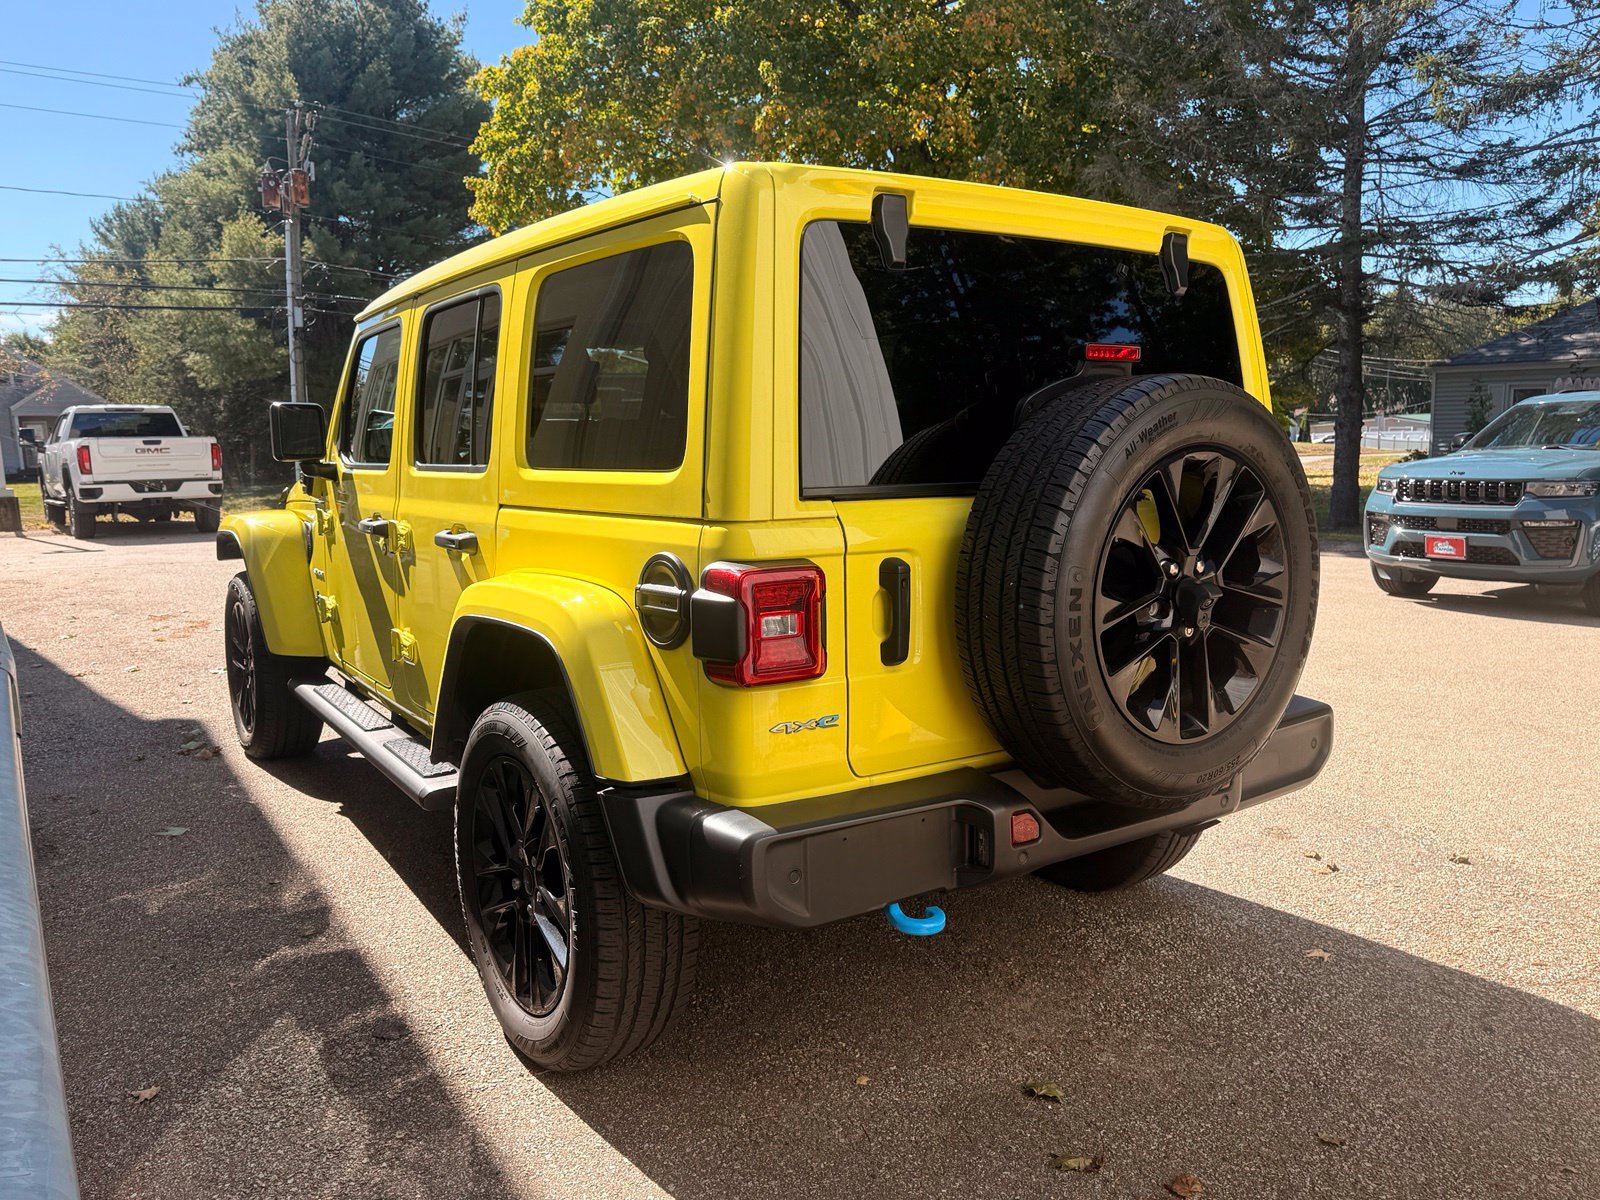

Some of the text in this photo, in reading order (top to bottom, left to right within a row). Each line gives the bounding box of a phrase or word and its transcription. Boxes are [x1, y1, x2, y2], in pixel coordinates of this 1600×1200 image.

[1124, 411, 1178, 460] All-Weather
[1068, 587, 1097, 711] NEXEN
[768, 714, 839, 734] 4xe
[1196, 755, 1241, 784] 255/60R20
